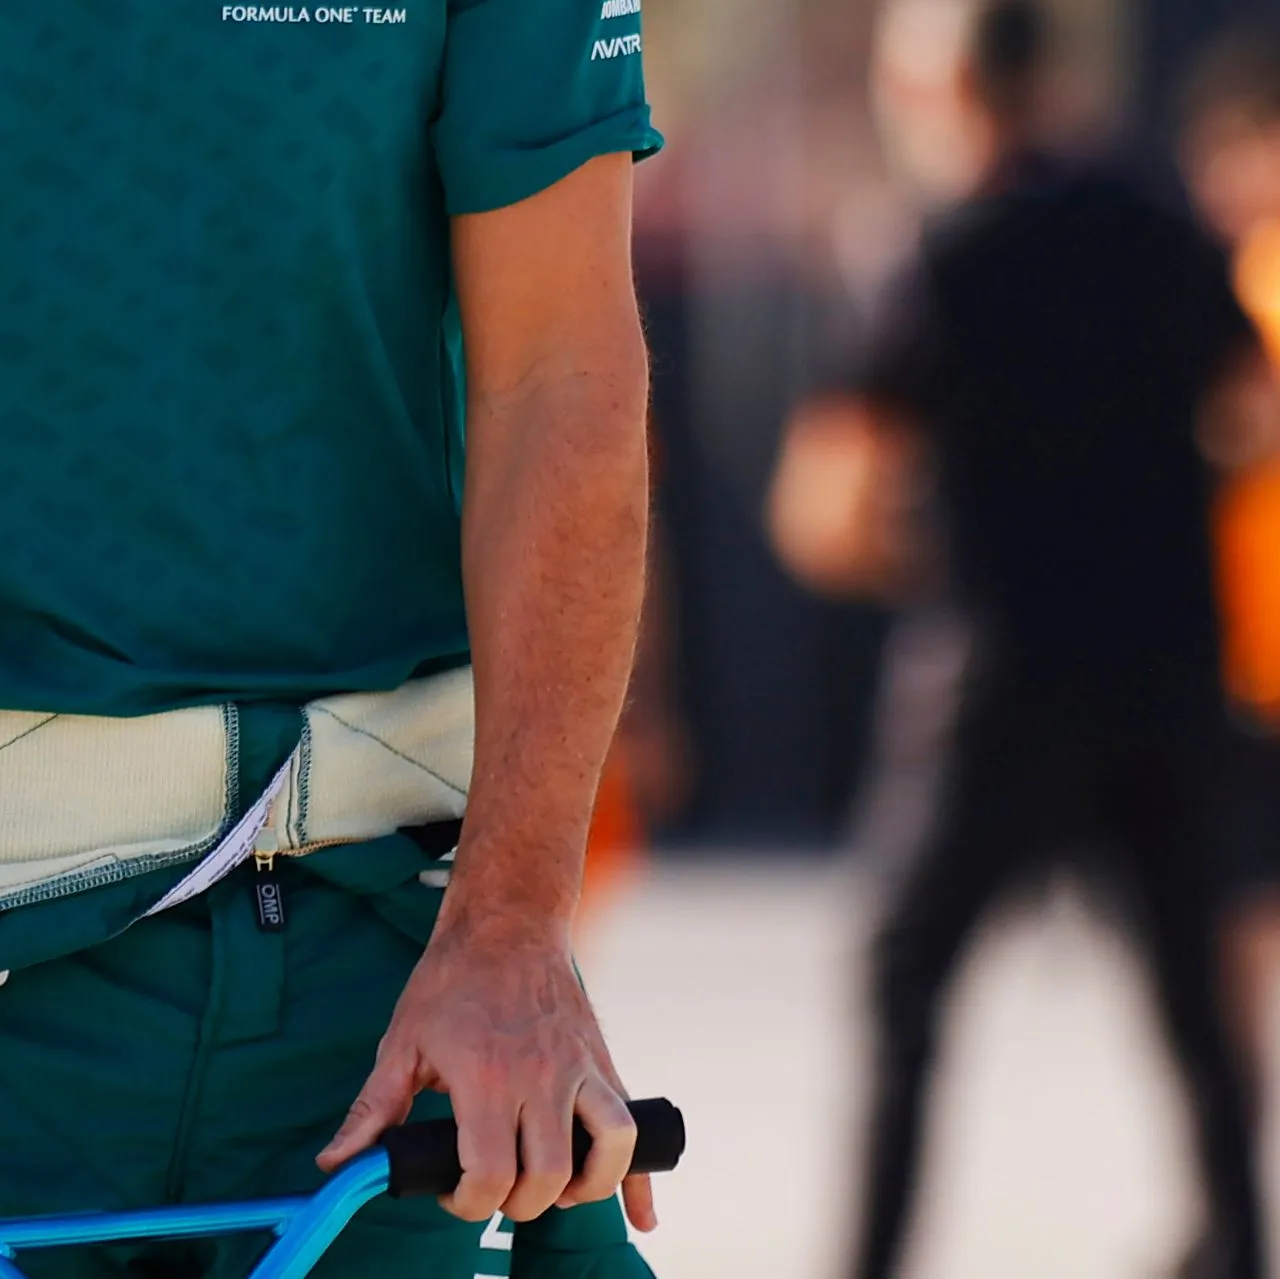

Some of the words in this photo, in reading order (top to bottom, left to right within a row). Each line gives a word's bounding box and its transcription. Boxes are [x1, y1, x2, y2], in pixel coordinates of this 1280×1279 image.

[222, 6, 310, 23] FORMULA
[362, 8, 406, 24] TEAM
[591, 33, 642, 61] AVATR
[261, 884, 280, 925] OMP
